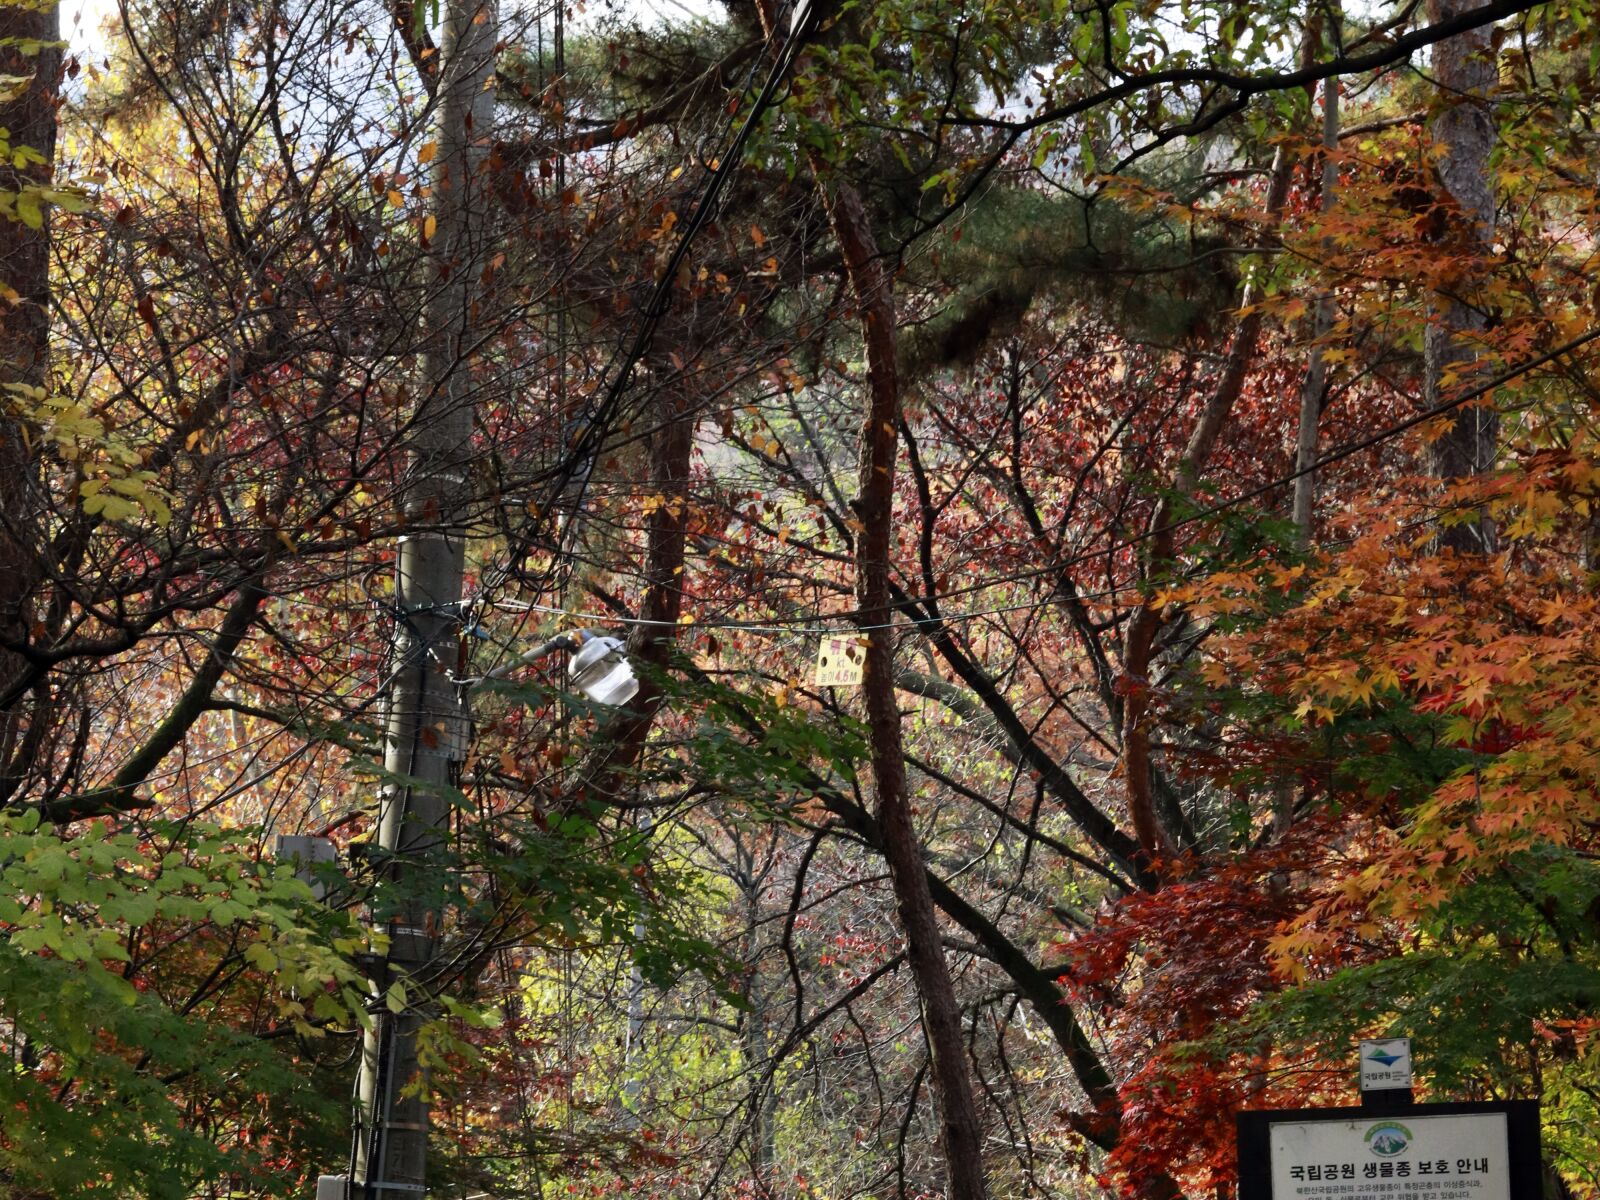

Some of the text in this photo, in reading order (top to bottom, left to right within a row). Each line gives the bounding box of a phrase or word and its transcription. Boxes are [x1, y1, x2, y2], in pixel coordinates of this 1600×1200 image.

[1364, 1072, 1391, 1081] 국립공원
[1290, 1158, 1488, 1181] 국립공원 생물종 보호 안내
[1296, 1184, 1354, 1195] 북한산국립공원의
[1358, 1182, 1401, 1193] 고유생물종이
[1404, 1181, 1440, 1190] 특정곤충의
[1398, 1192, 1419, 1200] 위협을
[1422, 1192, 1437, 1200] 받고
